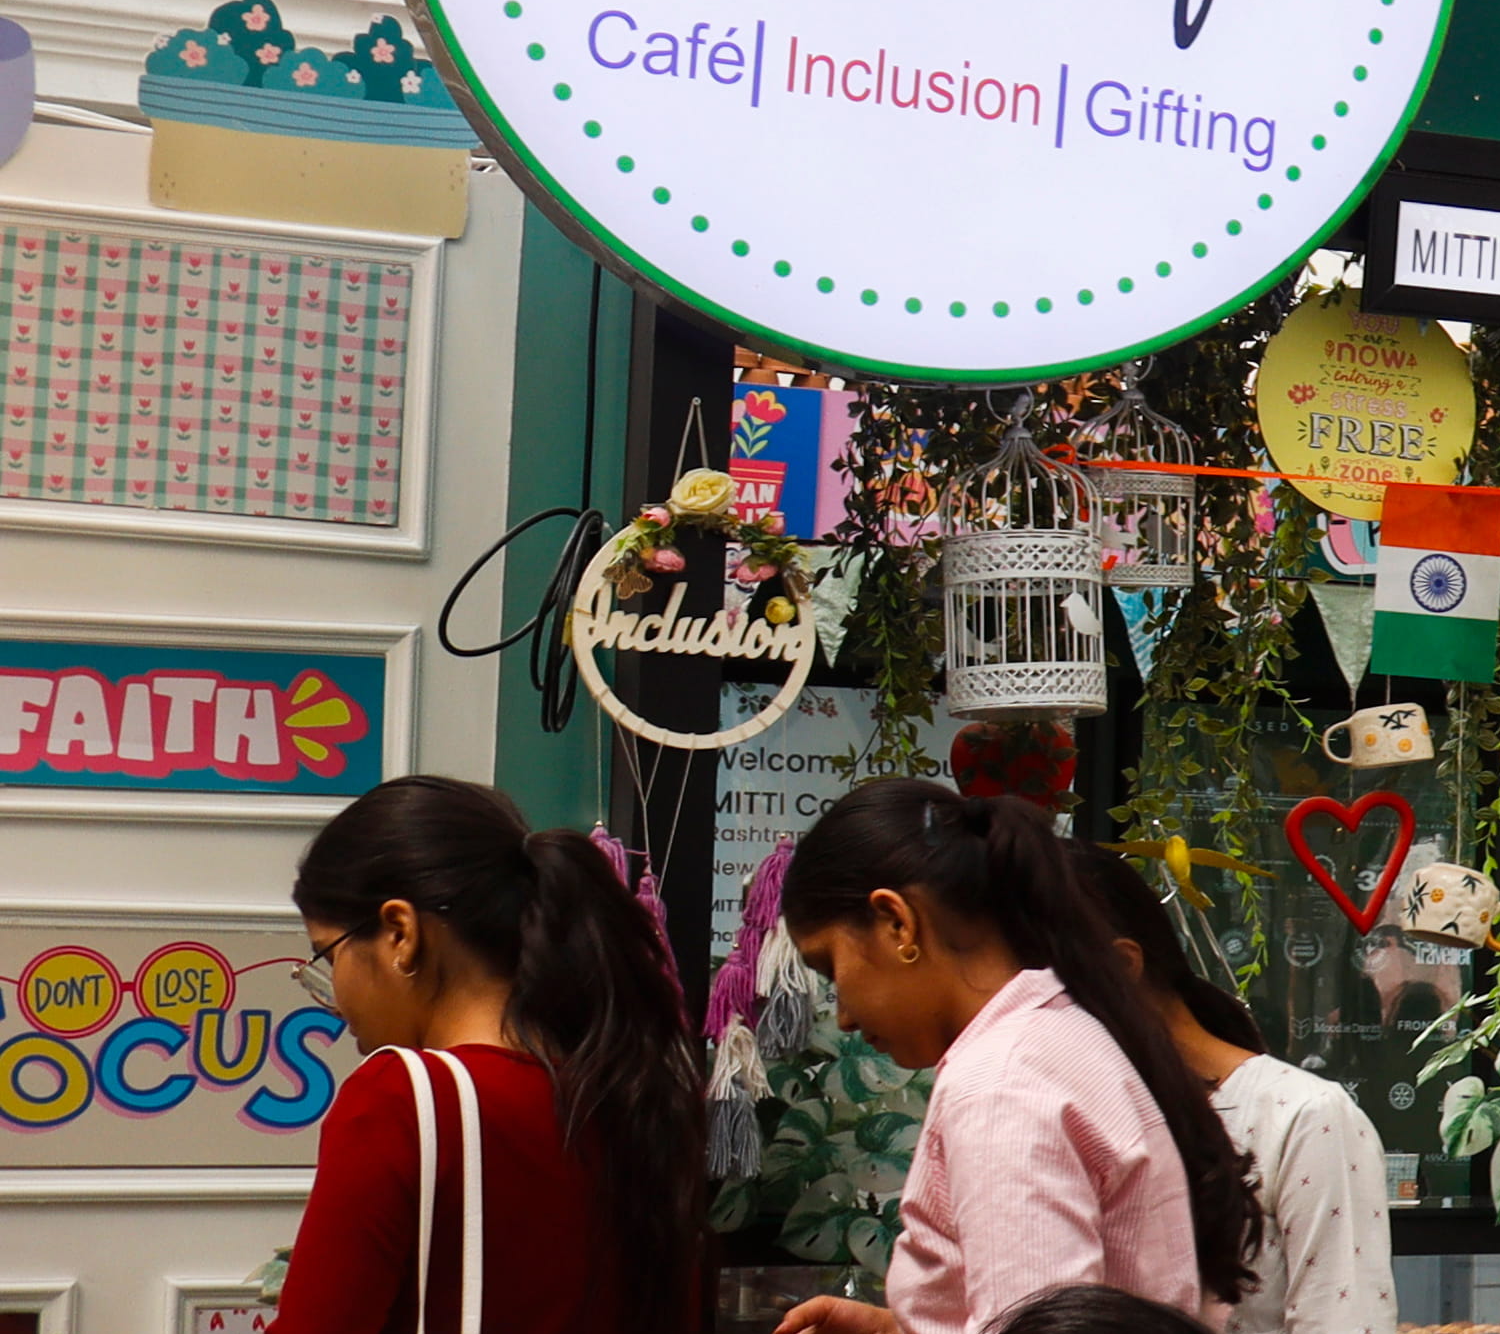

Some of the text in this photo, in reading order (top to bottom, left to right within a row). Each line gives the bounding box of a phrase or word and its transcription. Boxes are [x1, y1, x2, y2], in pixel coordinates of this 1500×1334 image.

[1085, 79, 1278, 172] Gifting
[1411, 228, 1498, 278] MITTI
[1336, 341, 1407, 369] now
[1333, 369, 1393, 396] entering
[1330, 391, 1408, 418] stress
[1309, 411, 1426, 461] FREE
[1338, 463, 1393, 483] zone
[588, 582, 804, 663] Inclusion
[0, 674, 282, 765] FAITH
[719, 747, 857, 774] Welcom
[34, 972, 107, 1010] DON'T
[153, 966, 215, 1007] LOSE
[0, 1008, 348, 1129] OCUS
